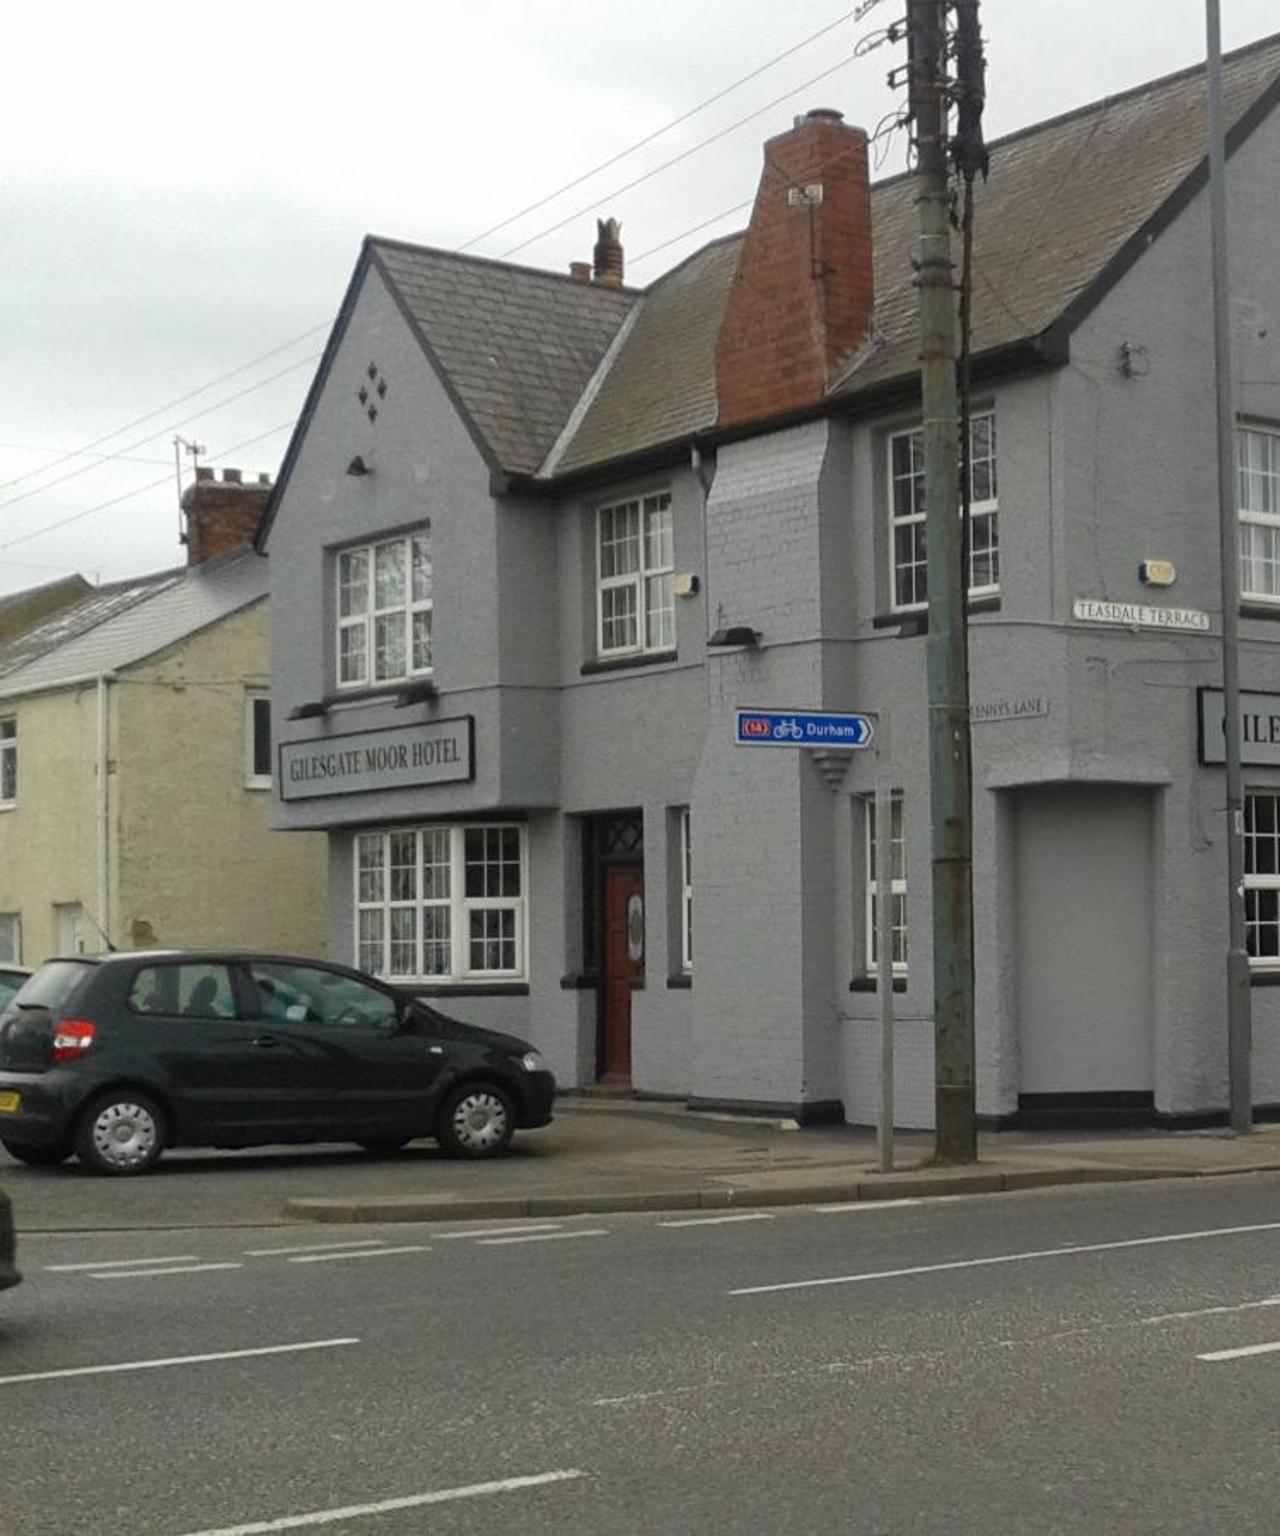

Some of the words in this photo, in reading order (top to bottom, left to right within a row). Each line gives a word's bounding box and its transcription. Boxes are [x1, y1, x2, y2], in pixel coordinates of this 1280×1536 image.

[1080, 603, 1145, 621] TEASDALE
[1149, 609, 1206, 627] TERRACE
[1013, 698, 1041, 714] LANE
[806, 723, 854, 737] Durham
[290, 750, 362, 781] GILESGATE
[365, 745, 408, 772] MOOR
[412, 738, 461, 767] HOTEL
